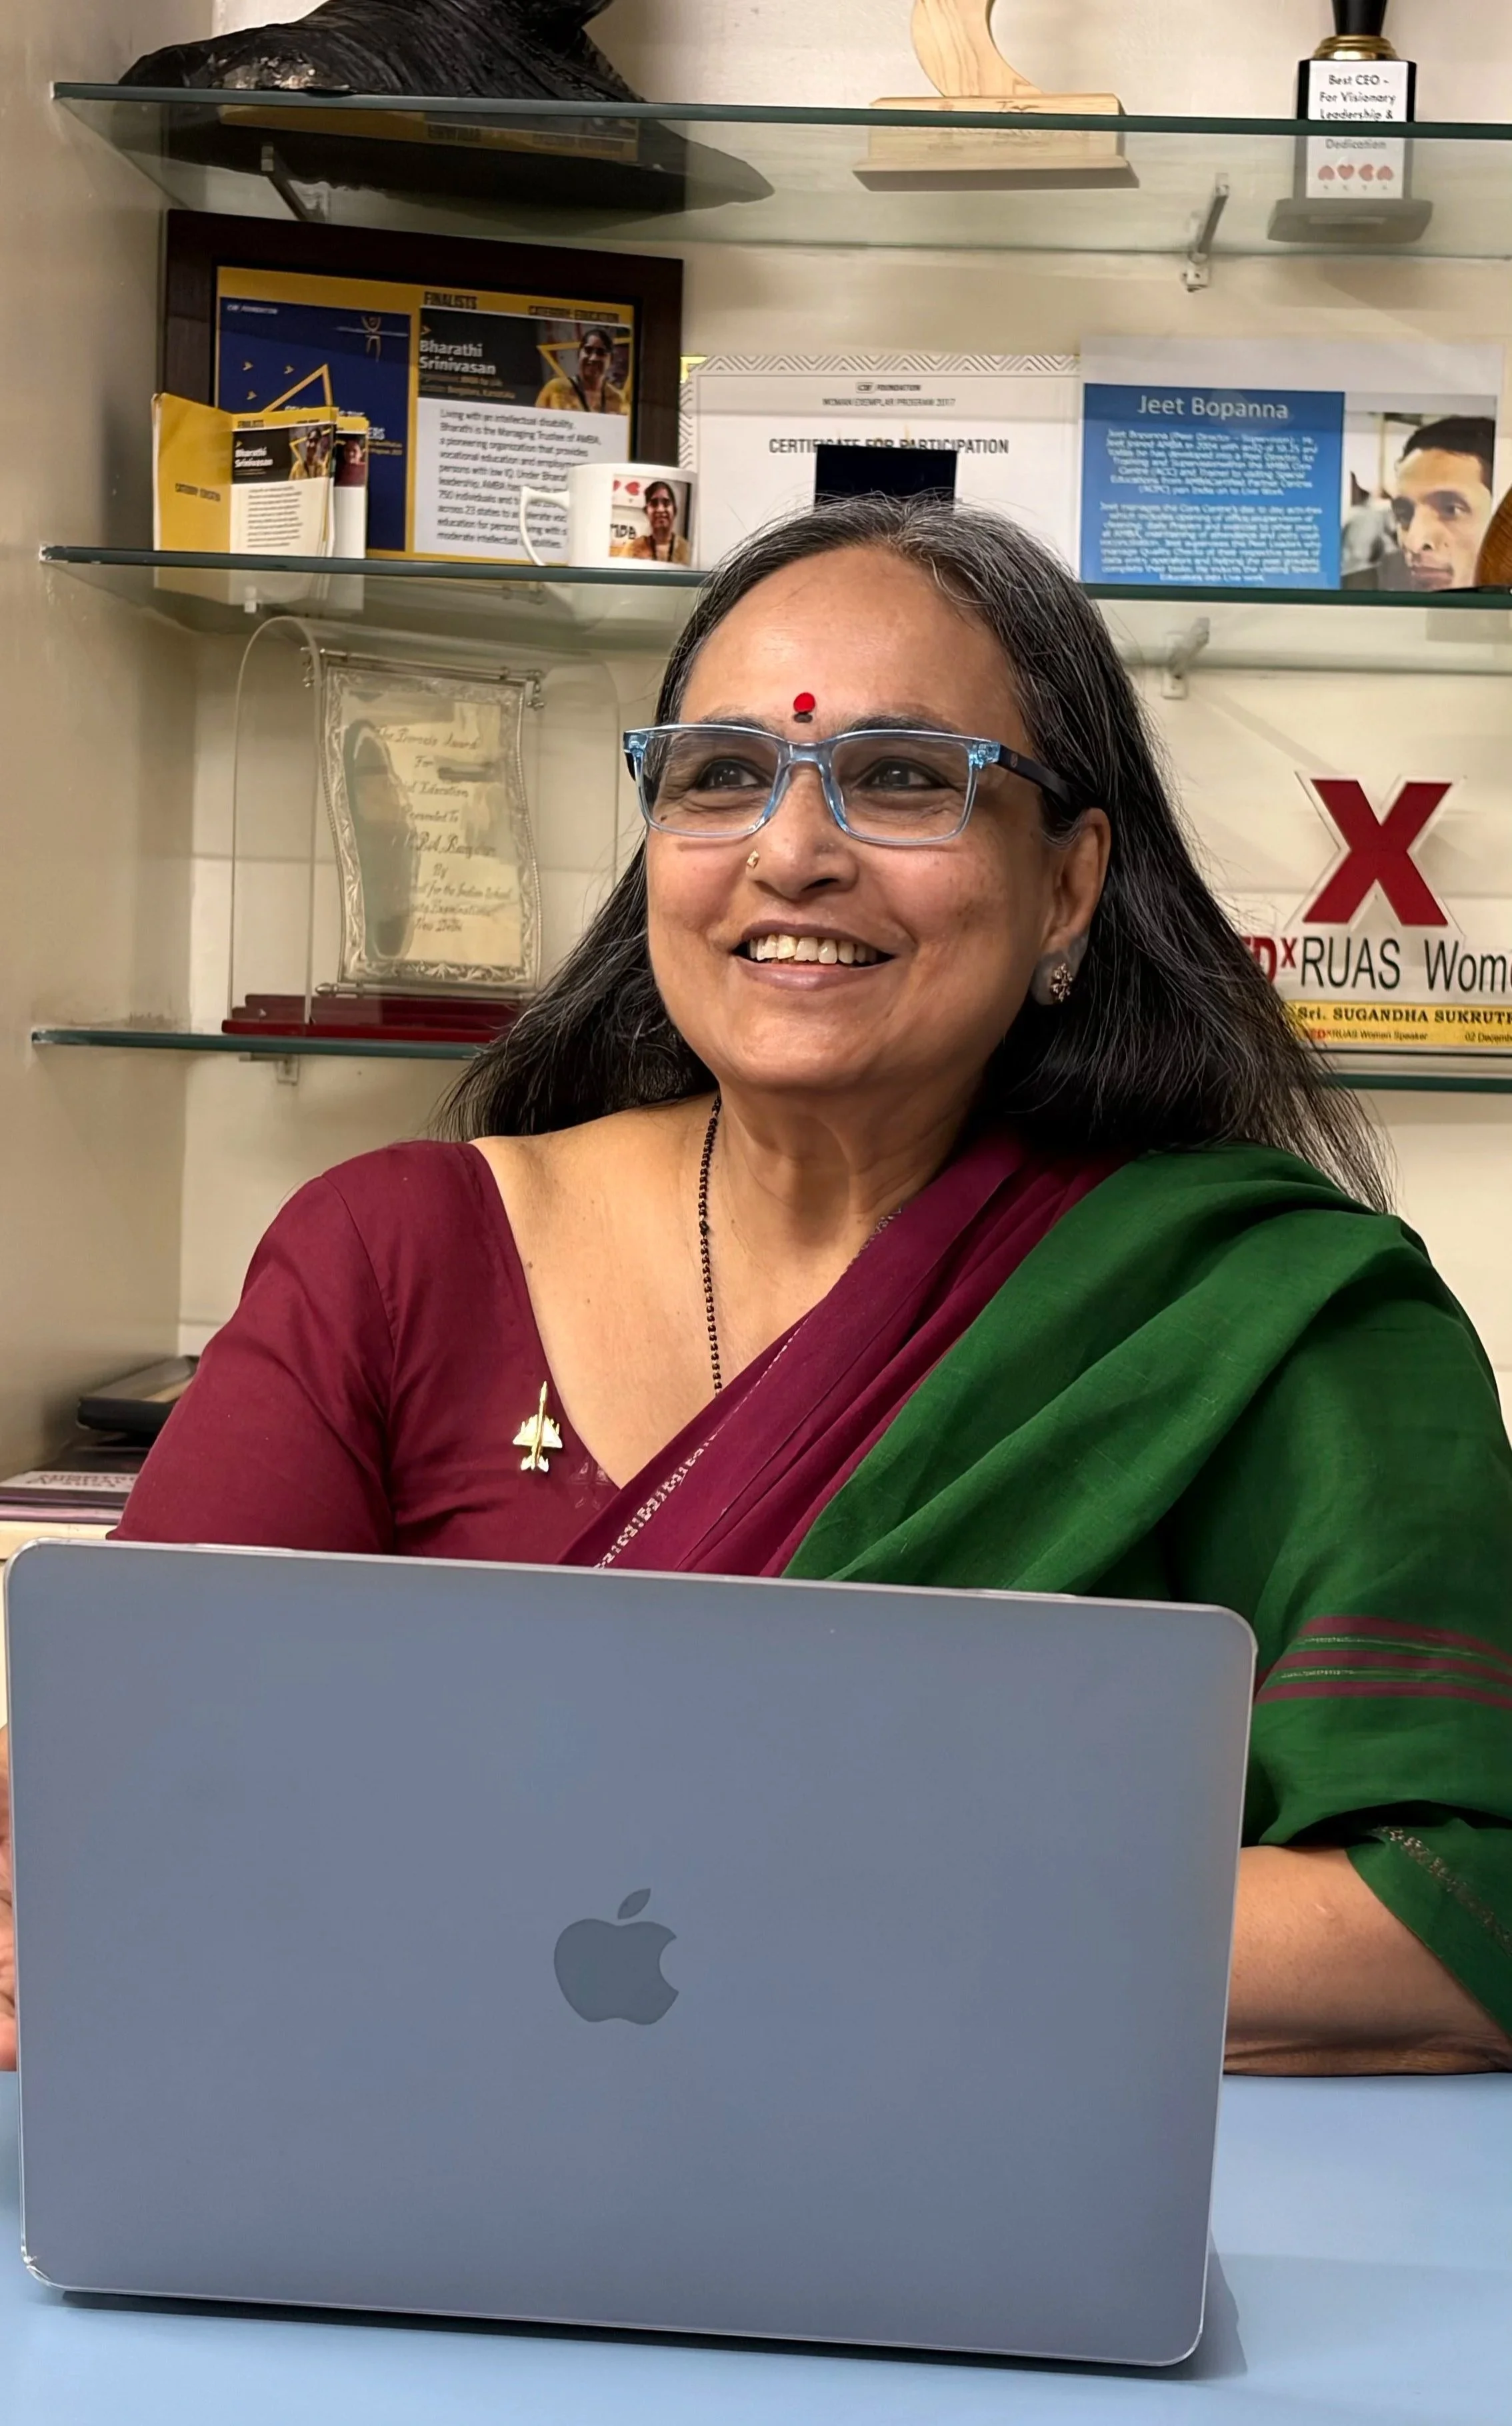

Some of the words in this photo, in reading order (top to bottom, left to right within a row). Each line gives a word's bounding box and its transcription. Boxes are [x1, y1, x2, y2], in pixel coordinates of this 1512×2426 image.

[1328, 75, 1352, 85] Best
[1355, 75, 1380, 85] CEO
[1320, 91, 1337, 102] For
[1340, 92, 1397, 105] Visionary
[1320, 109, 1382, 121] Leadership
[1385, 111, 1393, 119] &
[1325, 138, 1387, 149] Dedication
[424, 291, 478, 310] FINALISTS
[419, 339, 483, 357] Bharathi
[419, 356, 497, 375] Srinivasan
[1137, 395, 1184, 416] Jeet
[1191, 397, 1289, 420] Bopanna
[467, 411, 481, 419] with
[495, 415, 536, 426] intellectual
[483, 425, 496, 434] the
[1301, 779, 1453, 927] X
[1424, 939, 1512, 993] Wom
[1333, 1007, 1429, 1023] SUGANDHA
